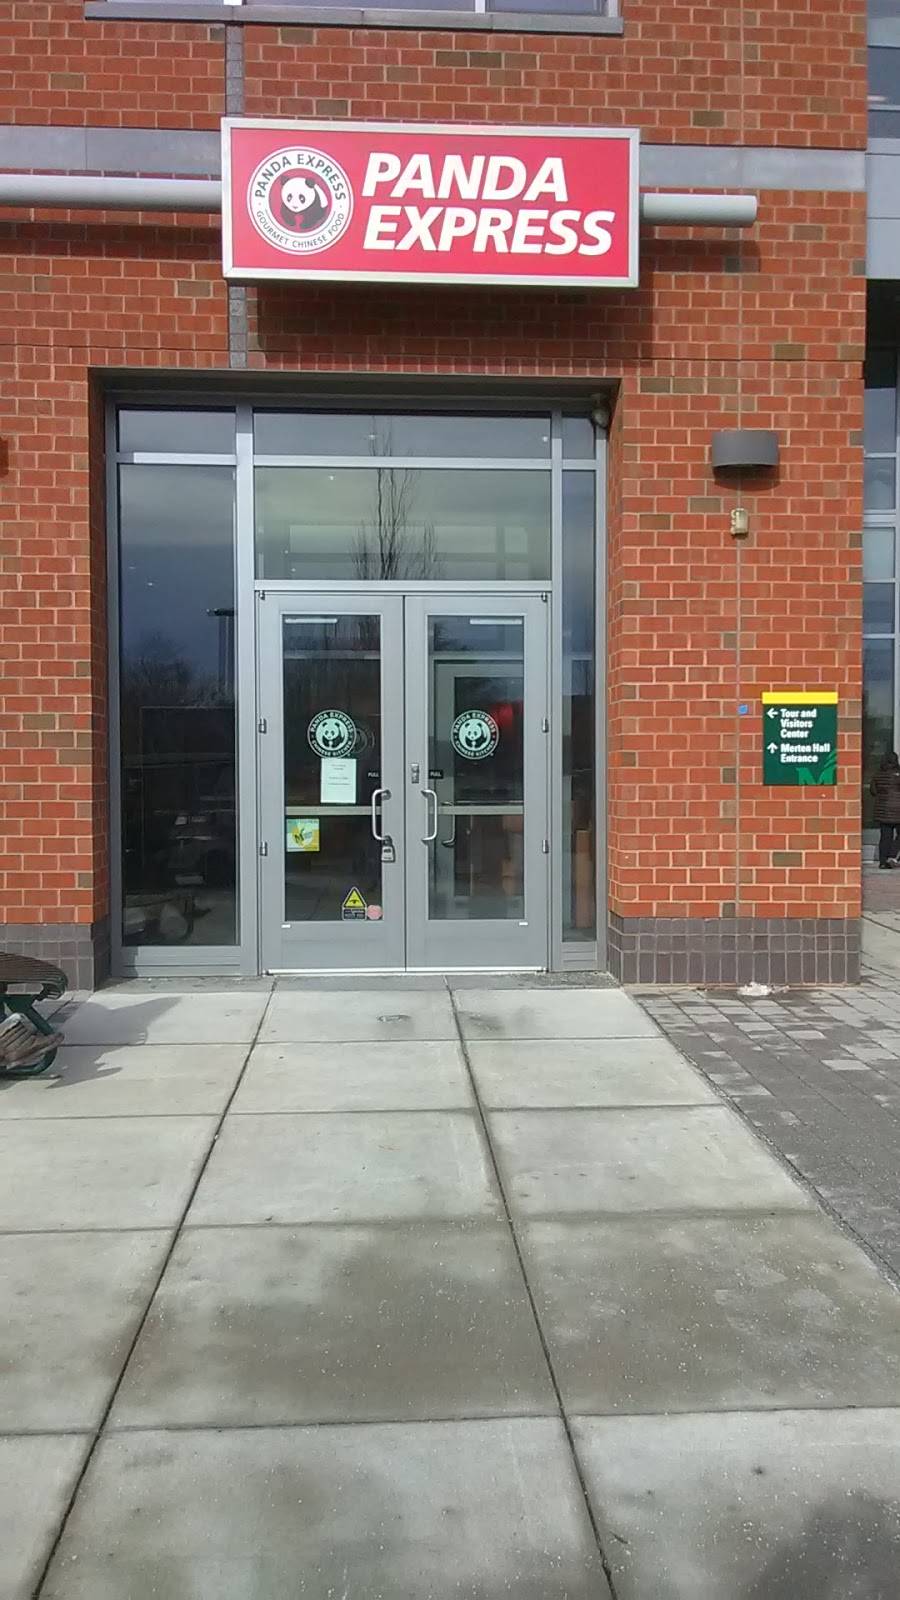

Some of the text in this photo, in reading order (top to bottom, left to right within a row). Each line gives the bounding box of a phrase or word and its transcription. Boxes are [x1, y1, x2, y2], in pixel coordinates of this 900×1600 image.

[254, 153, 347, 201] PANDA EXPRESS
[361, 152, 568, 202] PANDA
[256, 210, 345, 249] GOURMET CHINESE FOOD
[363, 205, 615, 256] EXPRESS
[310, 712, 354, 733] PANDA EXPRESS
[453, 712, 496, 733] PANDA EXPRESS
[780, 708, 817, 718] Tour and
[780, 718, 813, 728] Visitors
[780, 729, 809, 738] Center
[780, 743, 831, 753] Merten Hall
[780, 754, 818, 763] Entrance
